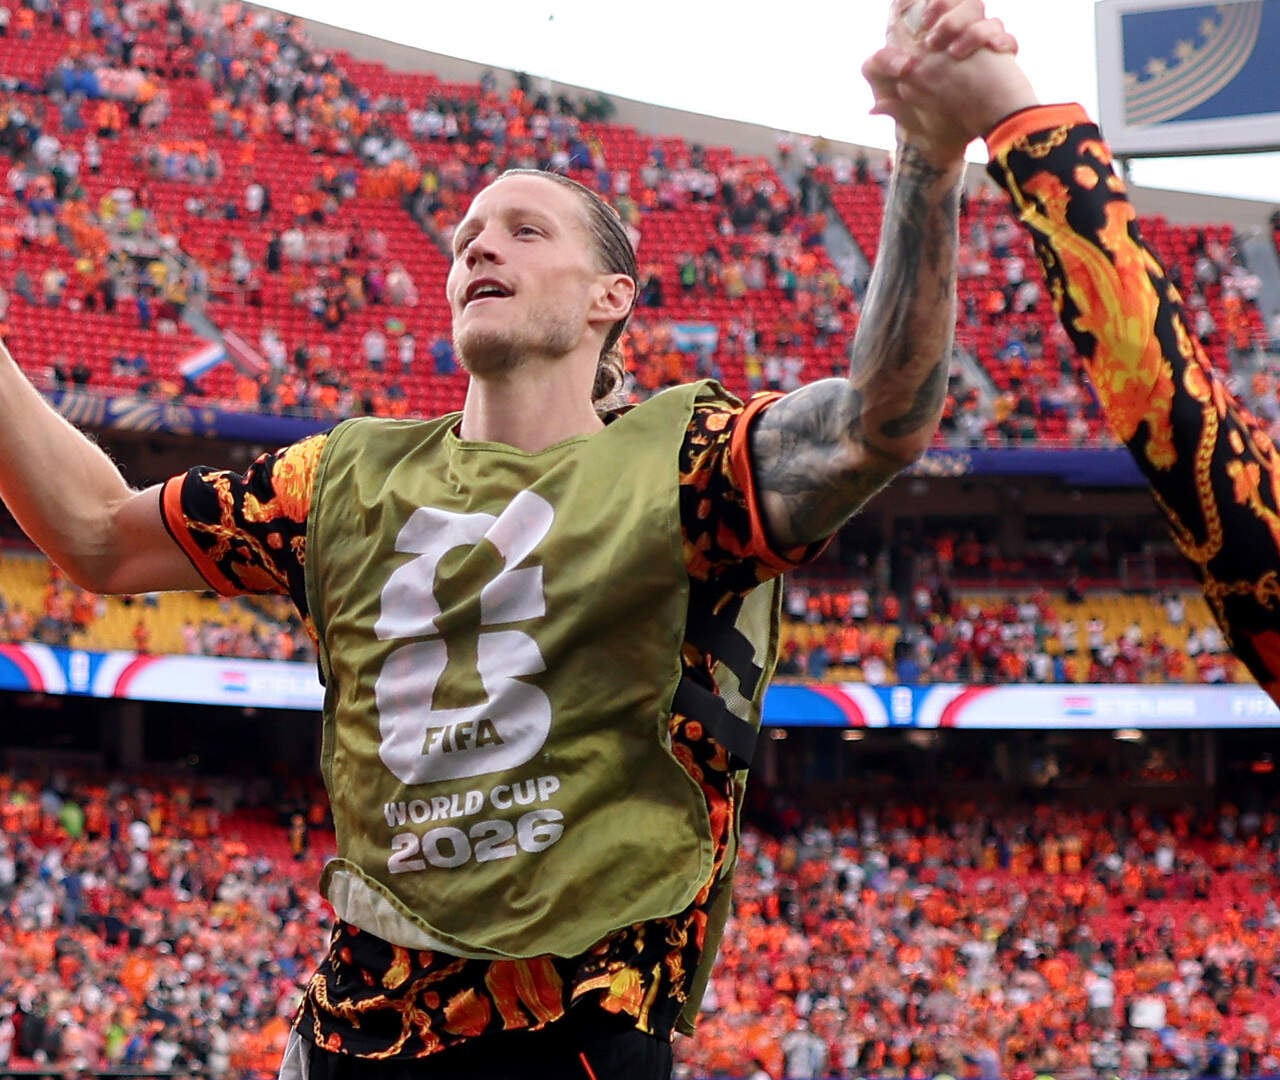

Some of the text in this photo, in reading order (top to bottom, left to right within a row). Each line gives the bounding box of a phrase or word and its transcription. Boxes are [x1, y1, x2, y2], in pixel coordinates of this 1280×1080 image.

[421, 718, 504, 756] FIFA
[384, 775, 560, 828] WORLD CUP
[387, 808, 565, 875] 2026
